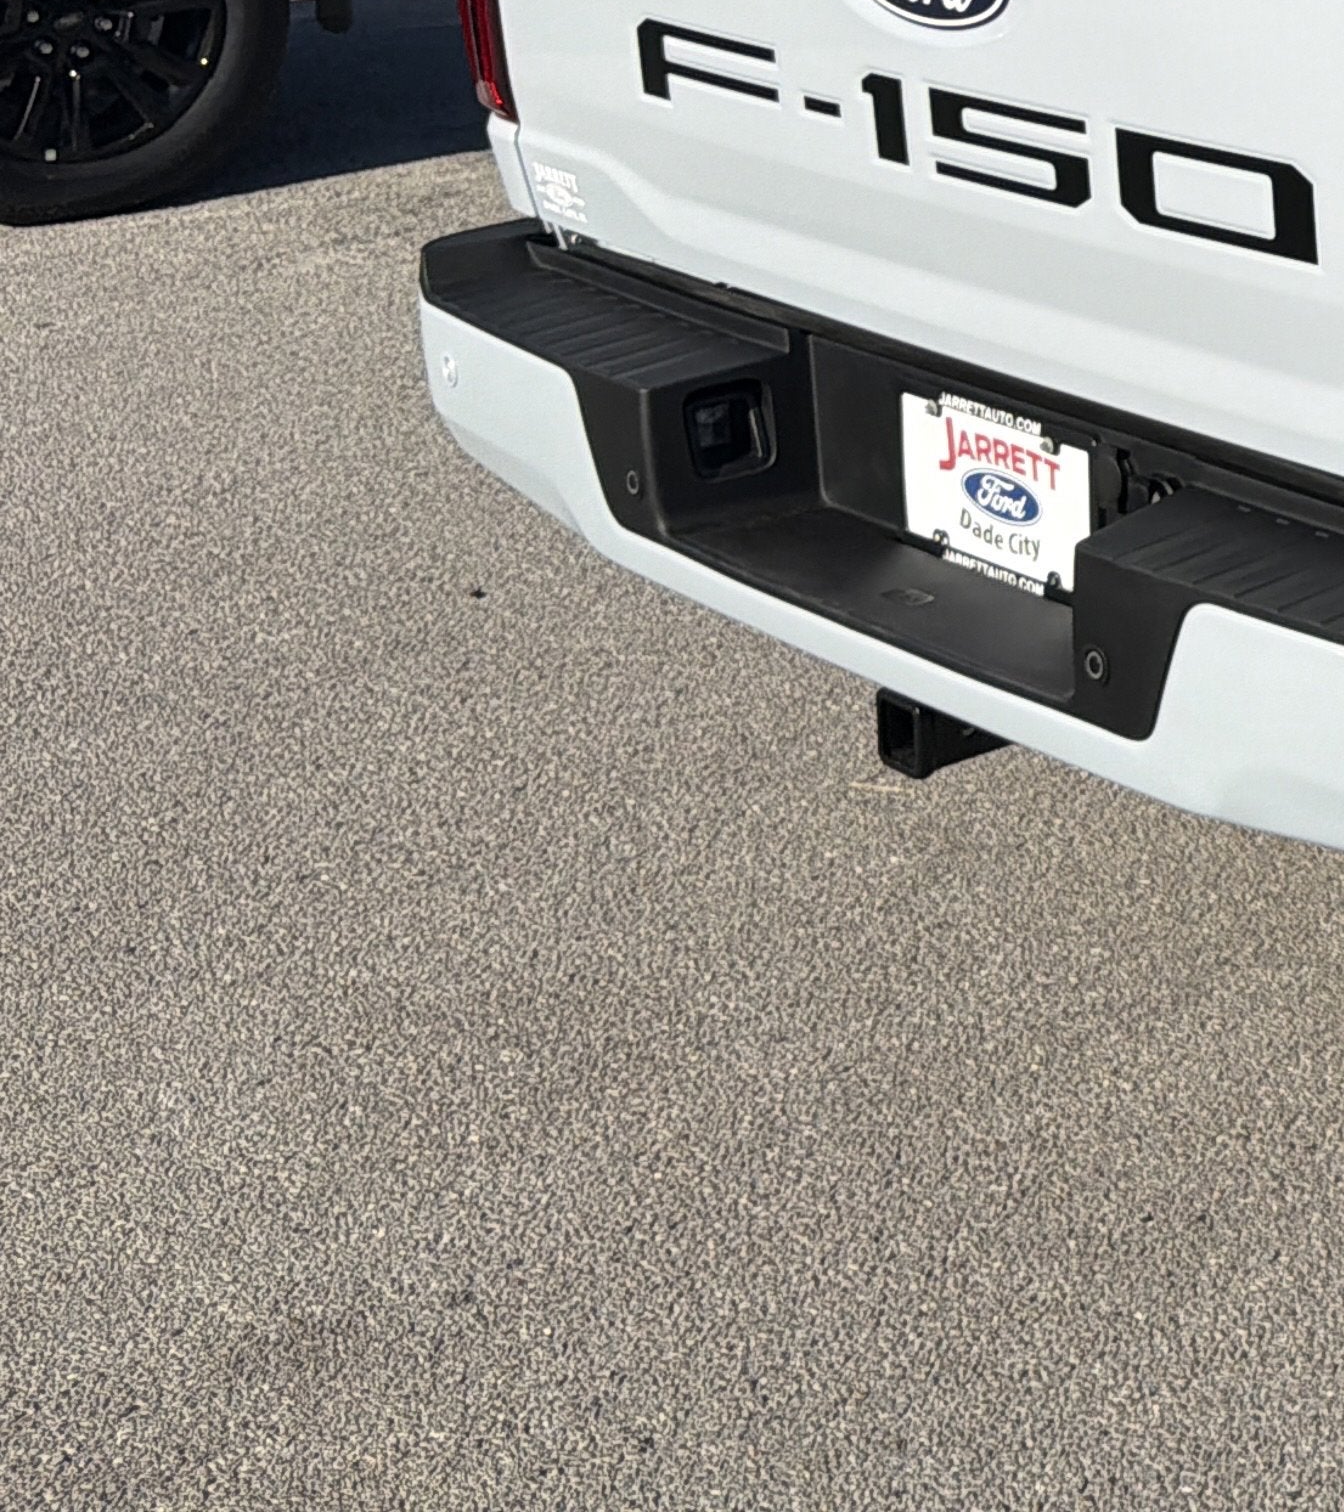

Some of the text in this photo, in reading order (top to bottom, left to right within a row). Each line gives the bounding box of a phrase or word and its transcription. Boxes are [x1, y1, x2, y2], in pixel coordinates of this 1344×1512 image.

[636, 18, 1319, 265] F-150
[938, 391, 1042, 437] JARRETTAUTO.COM
[939, 416, 1060, 491] JARRETT
[976, 473, 1027, 521] Ford
[959, 508, 1041, 562] Dade City
